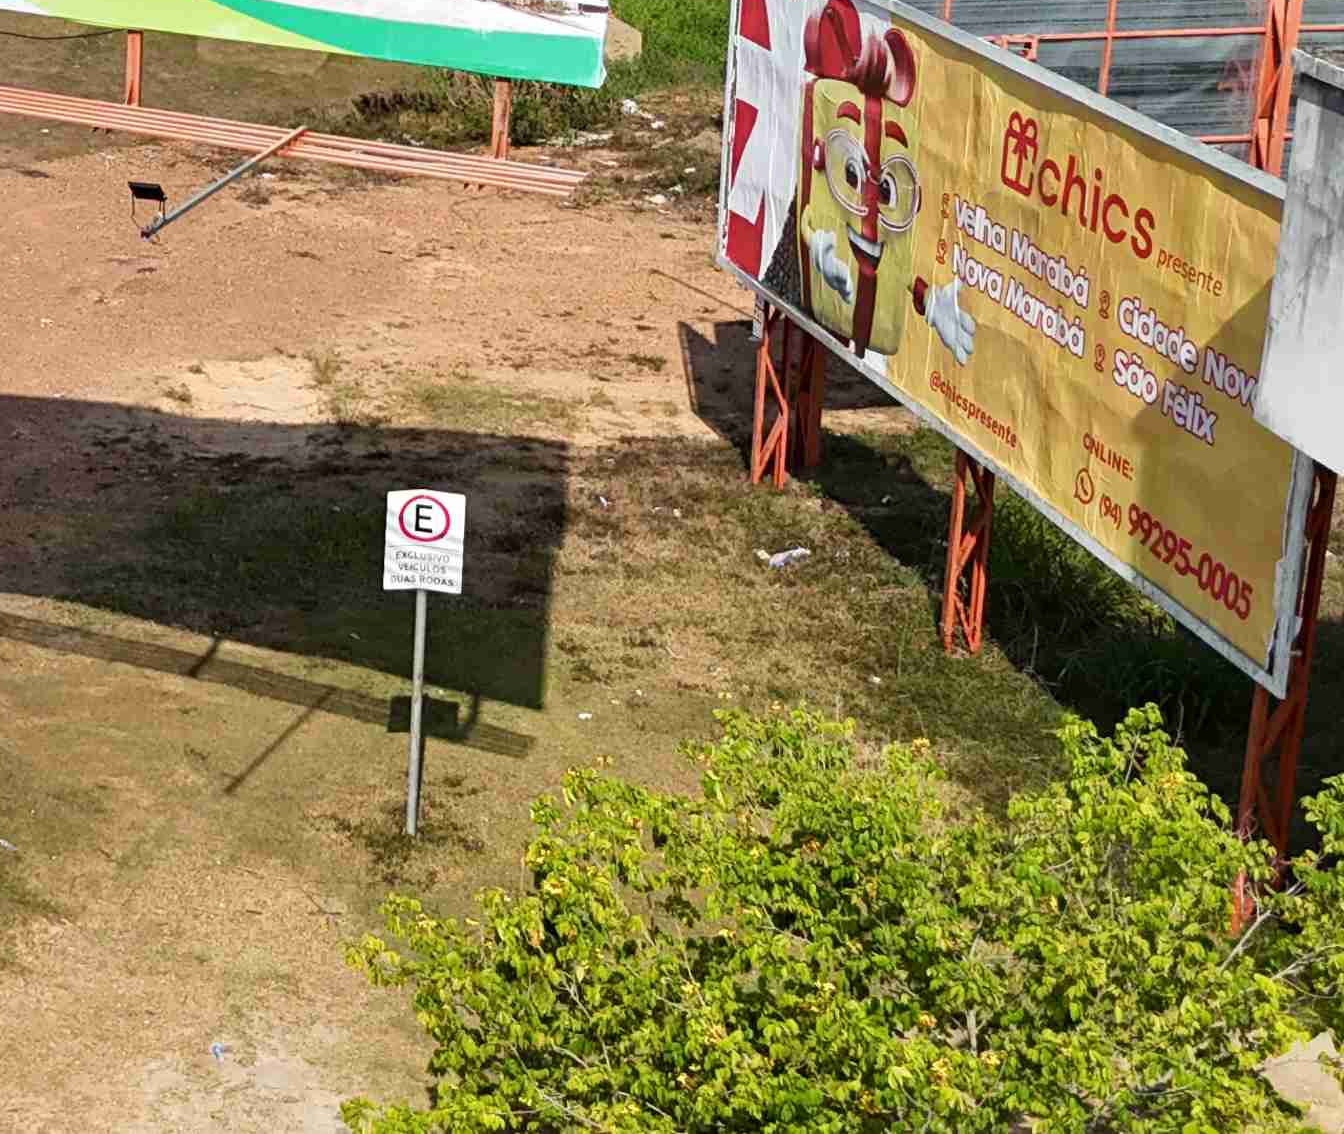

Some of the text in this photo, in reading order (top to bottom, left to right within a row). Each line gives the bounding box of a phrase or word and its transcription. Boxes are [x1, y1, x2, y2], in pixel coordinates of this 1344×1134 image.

[953, 194, 1089, 309] Velha Marabá
[1038, 153, 1155, 259] chics
[952, 242, 1085, 359] Nova Marabá
[1156, 249, 1224, 297] presente
[1112, 348, 1218, 446] São Félix
[1117, 296, 1258, 407] Cidade Nov
[930, 370, 1017, 448] @chicspresente
[1082, 432, 1134, 481] ONLINE:
[415, 504, 433, 533] E
[1099, 494, 1254, 621] (94) 99295-0005
